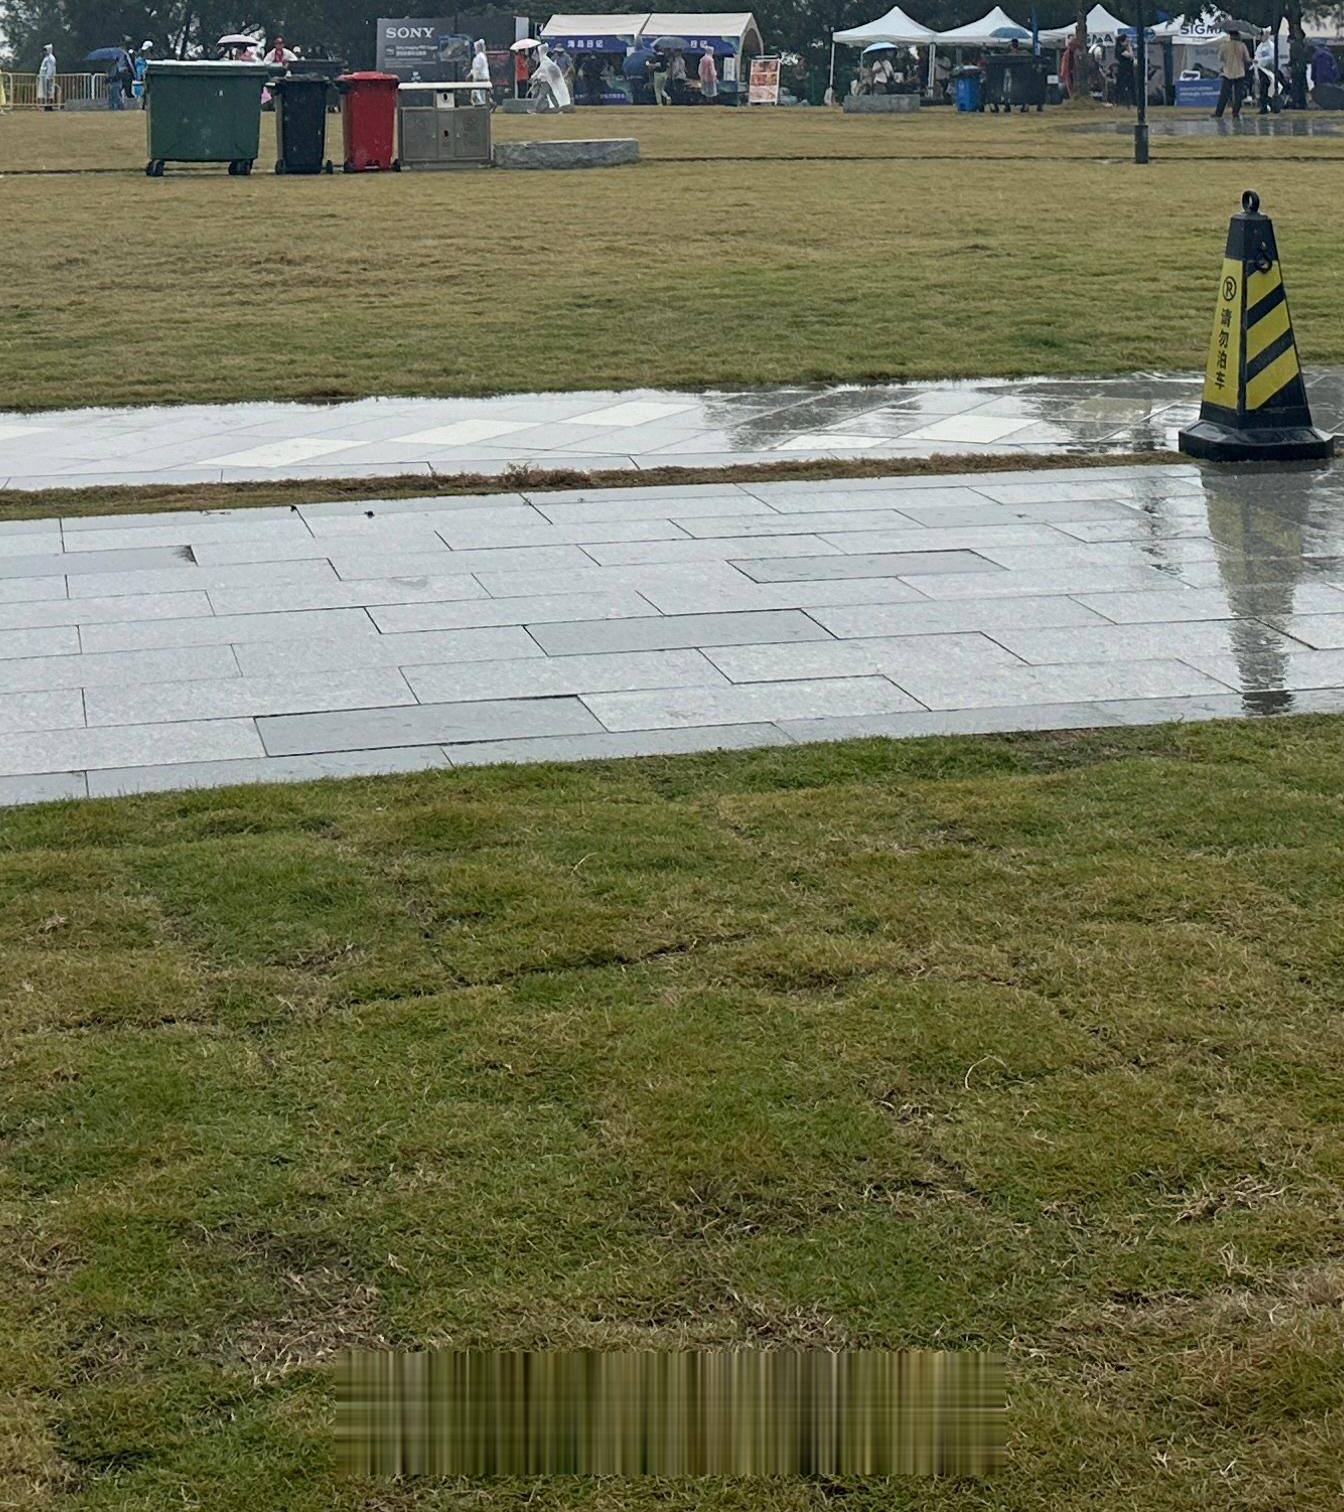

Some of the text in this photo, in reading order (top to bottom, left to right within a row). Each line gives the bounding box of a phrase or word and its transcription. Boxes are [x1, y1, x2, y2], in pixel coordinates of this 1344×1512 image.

[385, 27, 435, 38] SONY
[1180, 24, 1222, 35] SIGM
[690, 40, 709, 49] 日记
[1214, 308, 1233, 391] 请勿泊车
